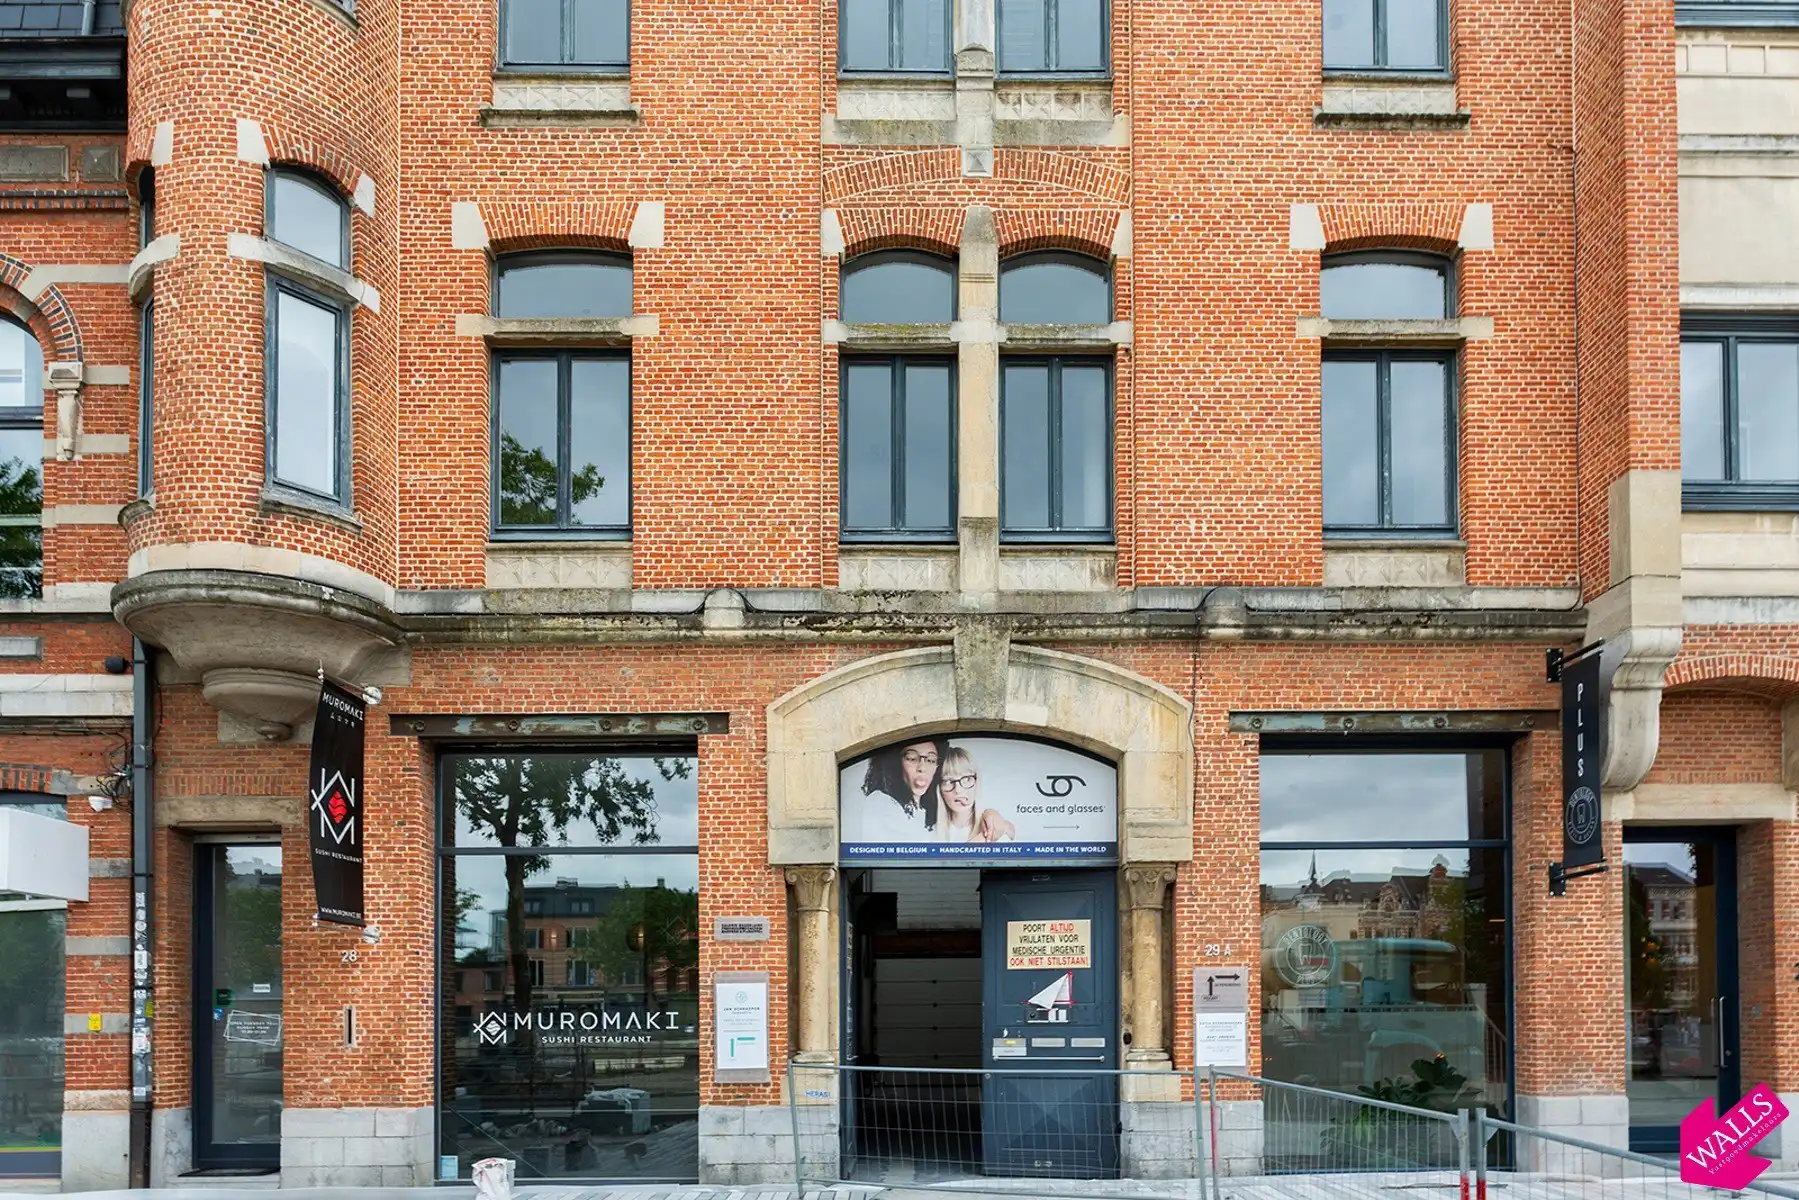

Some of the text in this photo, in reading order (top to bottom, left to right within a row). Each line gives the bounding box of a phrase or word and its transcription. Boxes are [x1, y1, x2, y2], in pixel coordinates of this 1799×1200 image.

[322, 692, 363, 721] MUROMAKI
[1016, 803, 1105, 815] faces and glasses
[315, 848, 363, 863] SUSHI RESTAURANT
[849, 846, 886, 854] DESIGNED
[886, 846, 895, 854] IN
[896, 846, 928, 854] BELGIUM
[939, 846, 992, 854] HANDCRAFTED
[1023, 922, 1075, 933] POORT ALTIJD
[1018, 934, 1079, 944] VRIJLATEN VOOR
[1012, 945, 1086, 955] MEDISCHE URGENTIE
[1204, 943, 1232, 957] 29 A
[341, 949, 358, 963] 28
[1009, 957, 1025, 967] OOK
[1028, 957, 1044, 966] NIET
[513, 1011, 680, 1031] MUROMAKI
[541, 1035, 652, 1044] SUSHI RESTAURANT
